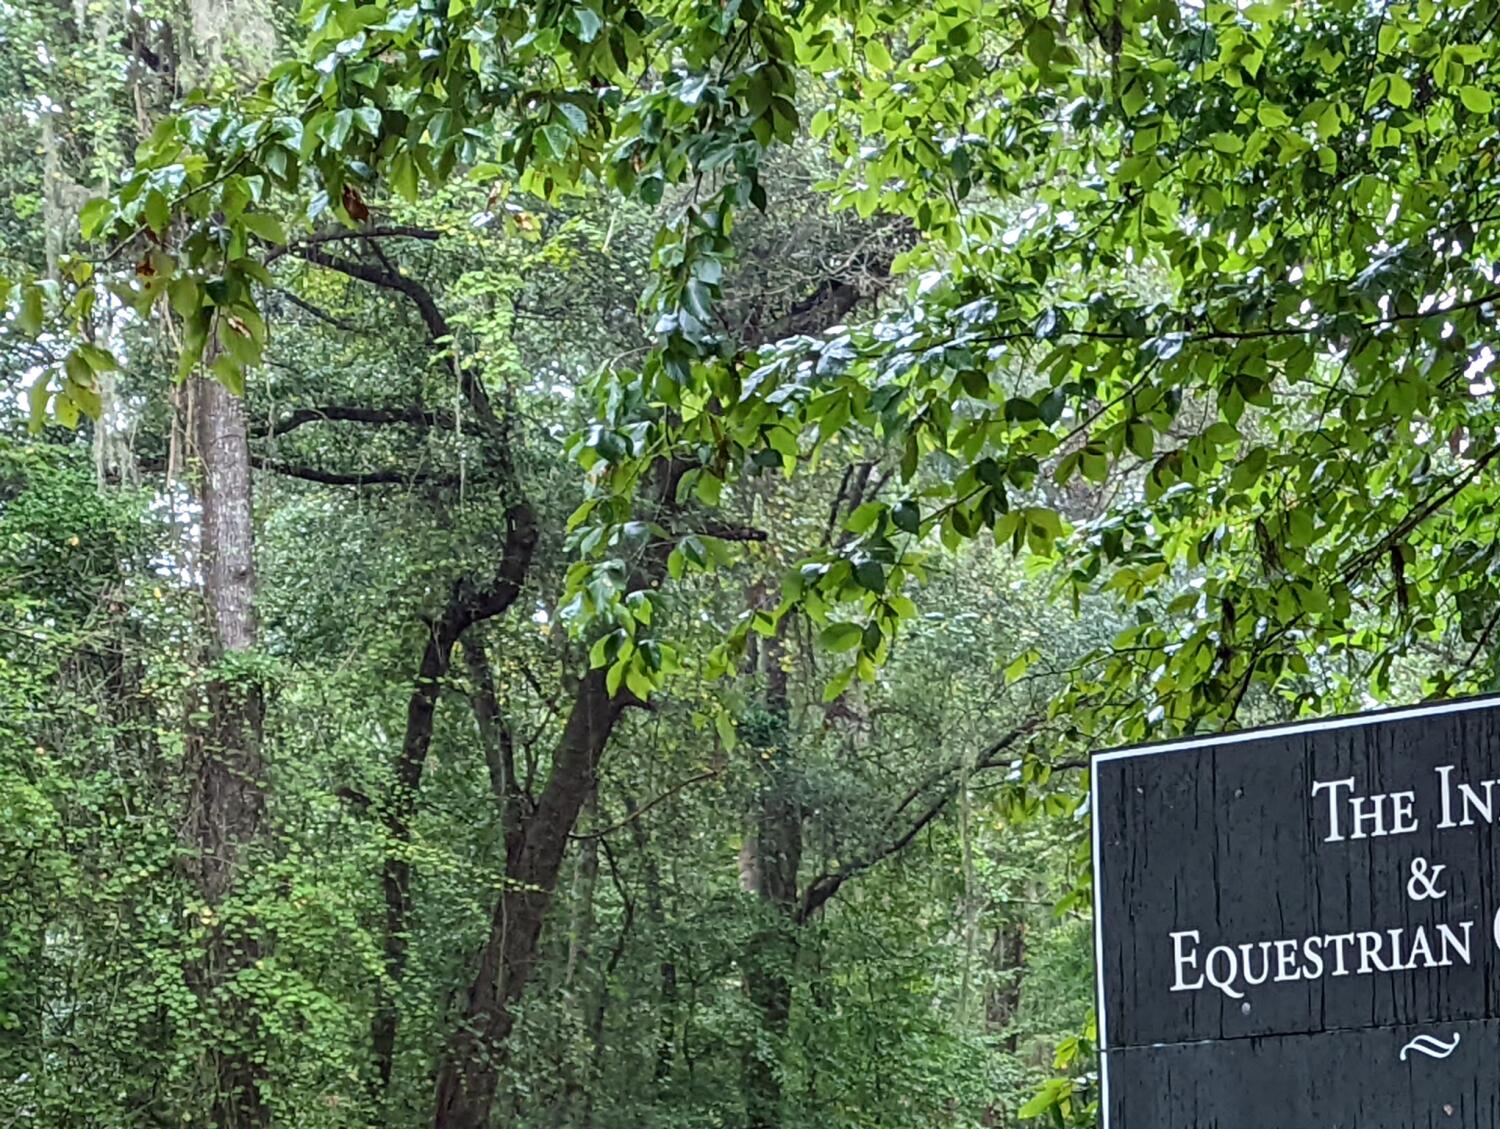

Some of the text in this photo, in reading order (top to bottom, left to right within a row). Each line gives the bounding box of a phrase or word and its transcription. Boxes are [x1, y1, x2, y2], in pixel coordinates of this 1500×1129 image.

[1310, 775, 1420, 844] THE
[1405, 856, 1448, 902] &
[1168, 919, 1475, 1000] EQUESTRIAN
